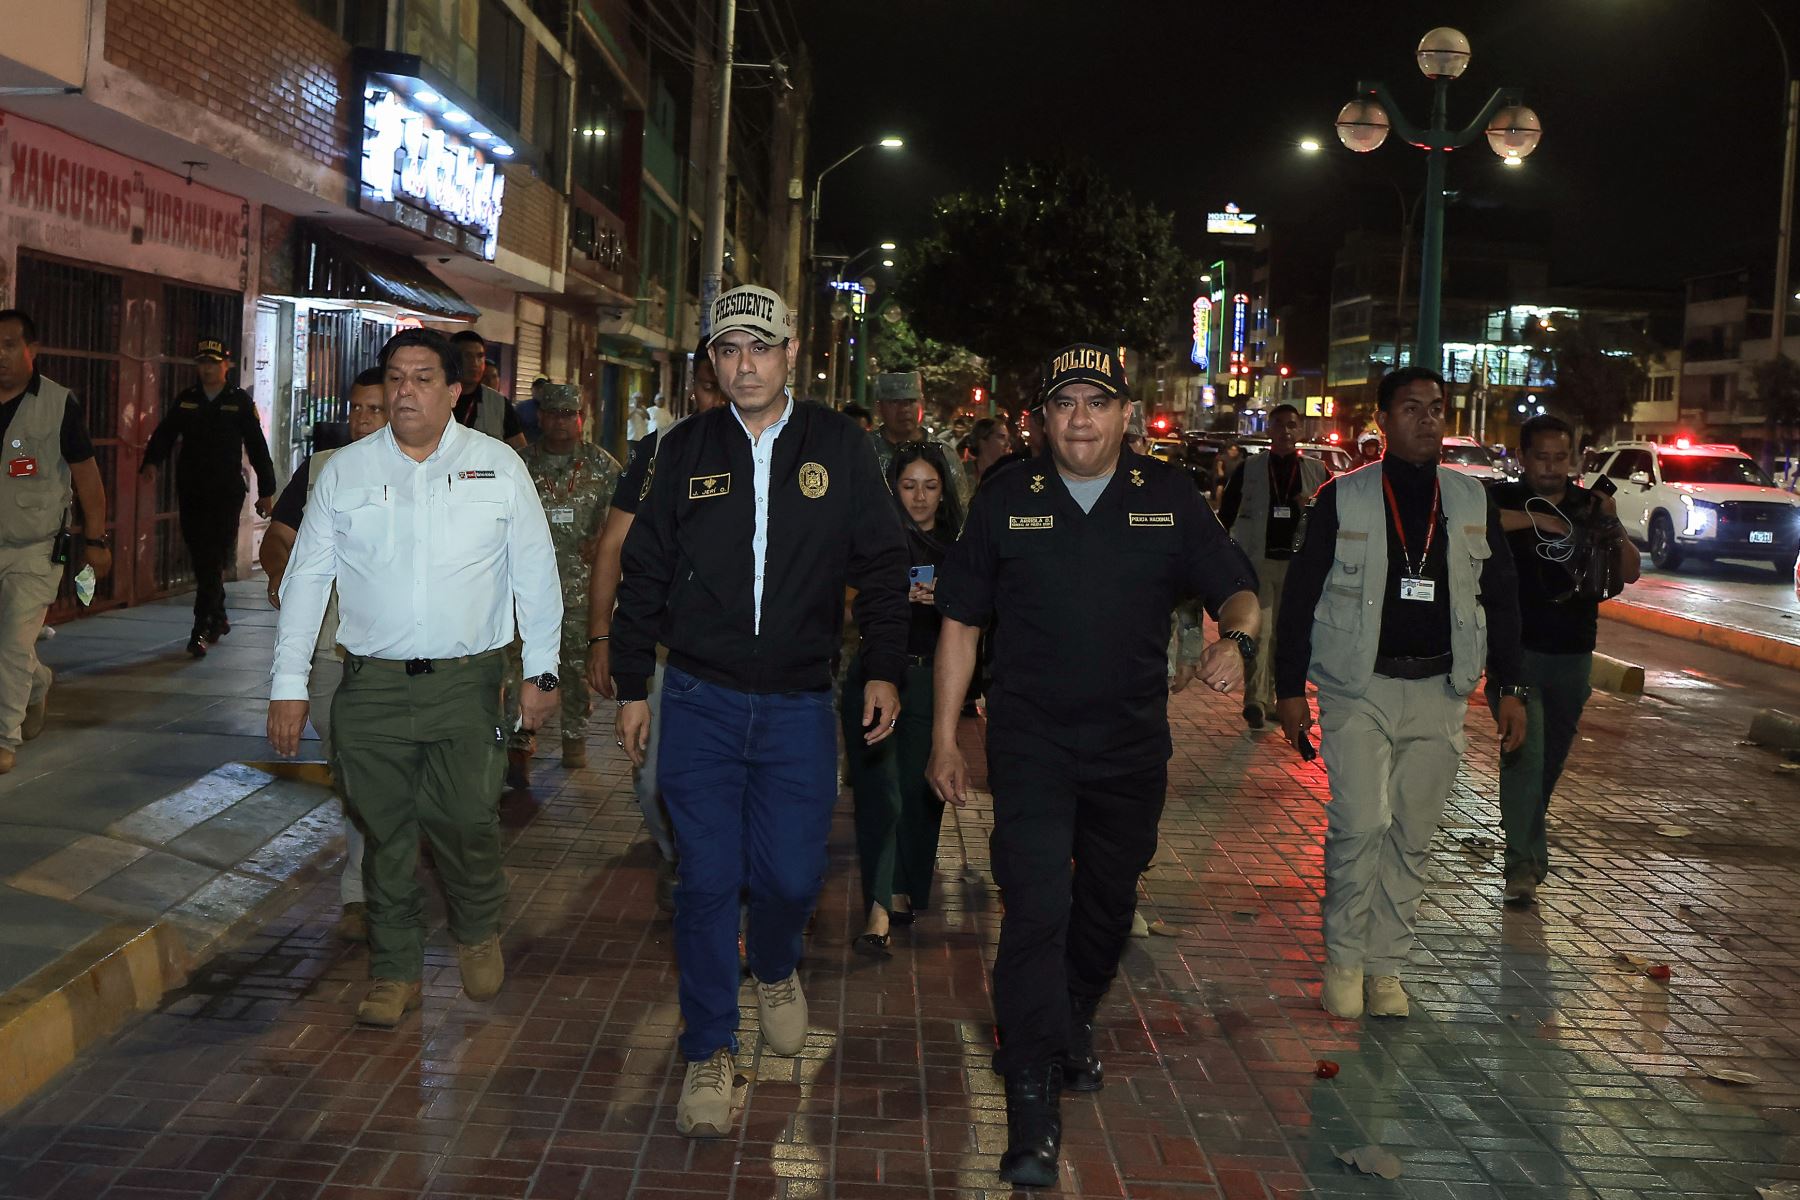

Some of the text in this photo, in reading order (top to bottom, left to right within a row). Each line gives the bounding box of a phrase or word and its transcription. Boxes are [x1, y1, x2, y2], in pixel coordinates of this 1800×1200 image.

[10, 141, 132, 232] MANGUERAS
[714, 292, 775, 324] PRESIDENTE
[1052, 348, 1112, 380] POLICIA
